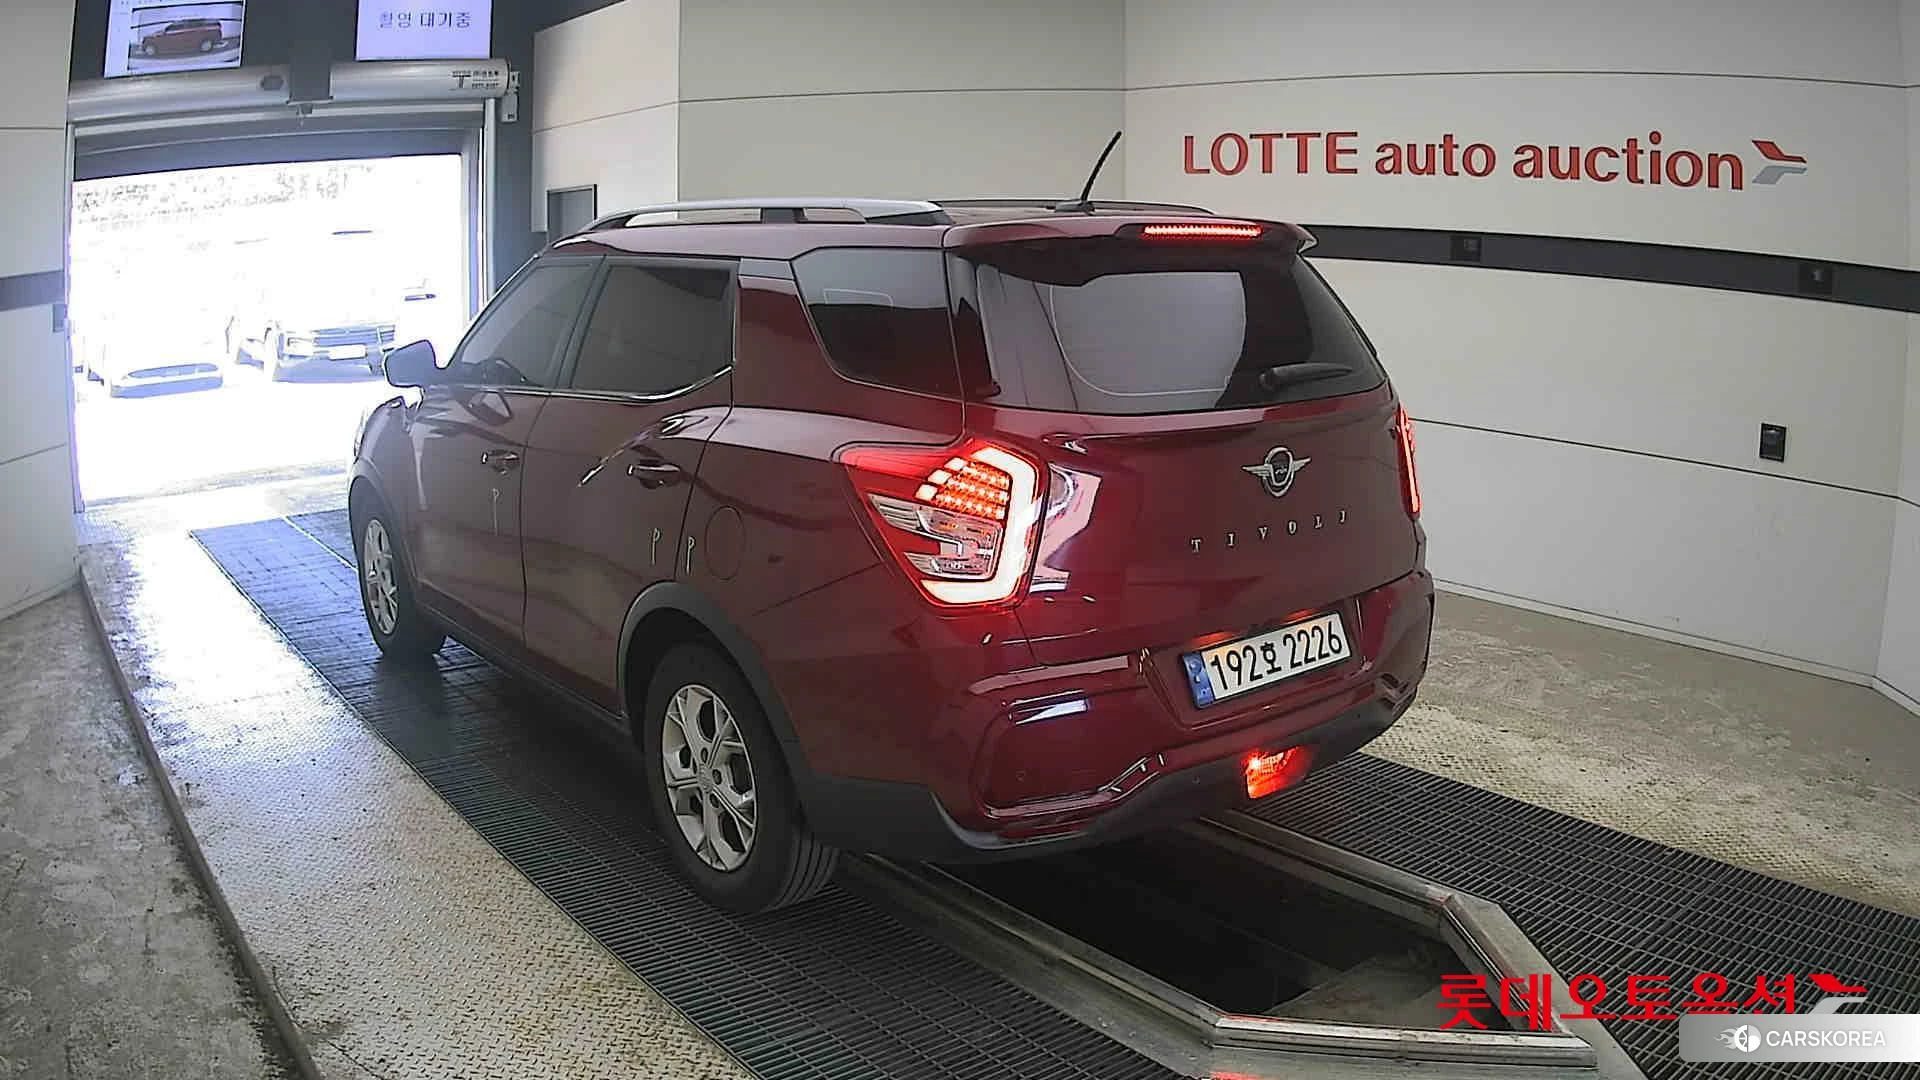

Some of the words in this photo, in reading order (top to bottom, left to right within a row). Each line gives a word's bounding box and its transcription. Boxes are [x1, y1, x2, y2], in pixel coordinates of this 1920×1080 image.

[420, 11, 472, 29] 대기중
[1184, 132, 1356, 176] LOTTE
[1375, 134, 1497, 177] auto
[1513, 132, 1743, 188] auction
[1191, 509, 1347, 553] TIVOLI
[1210, 641, 1282, 691] 192호
[1282, 620, 1343, 670] 2226
